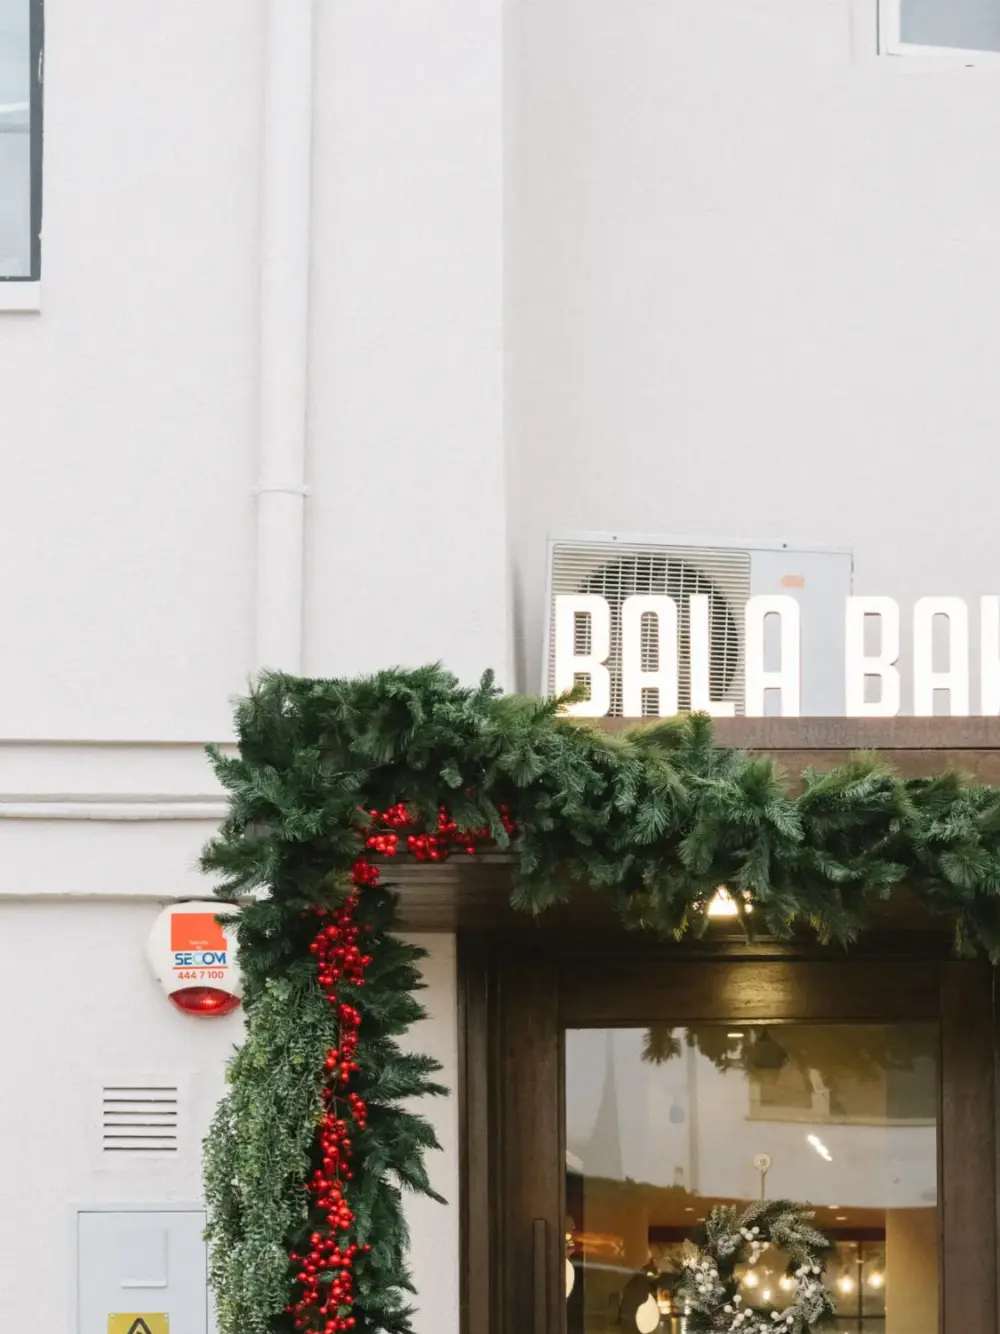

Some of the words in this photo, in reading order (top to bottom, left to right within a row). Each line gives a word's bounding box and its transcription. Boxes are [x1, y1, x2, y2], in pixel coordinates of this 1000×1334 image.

[555, 594, 801, 717] BALA
[175, 952, 226, 966] SECOM
[178, 971, 197, 979] 444
[200, 971, 205, 979] 7
[208, 970, 224, 979] 100
